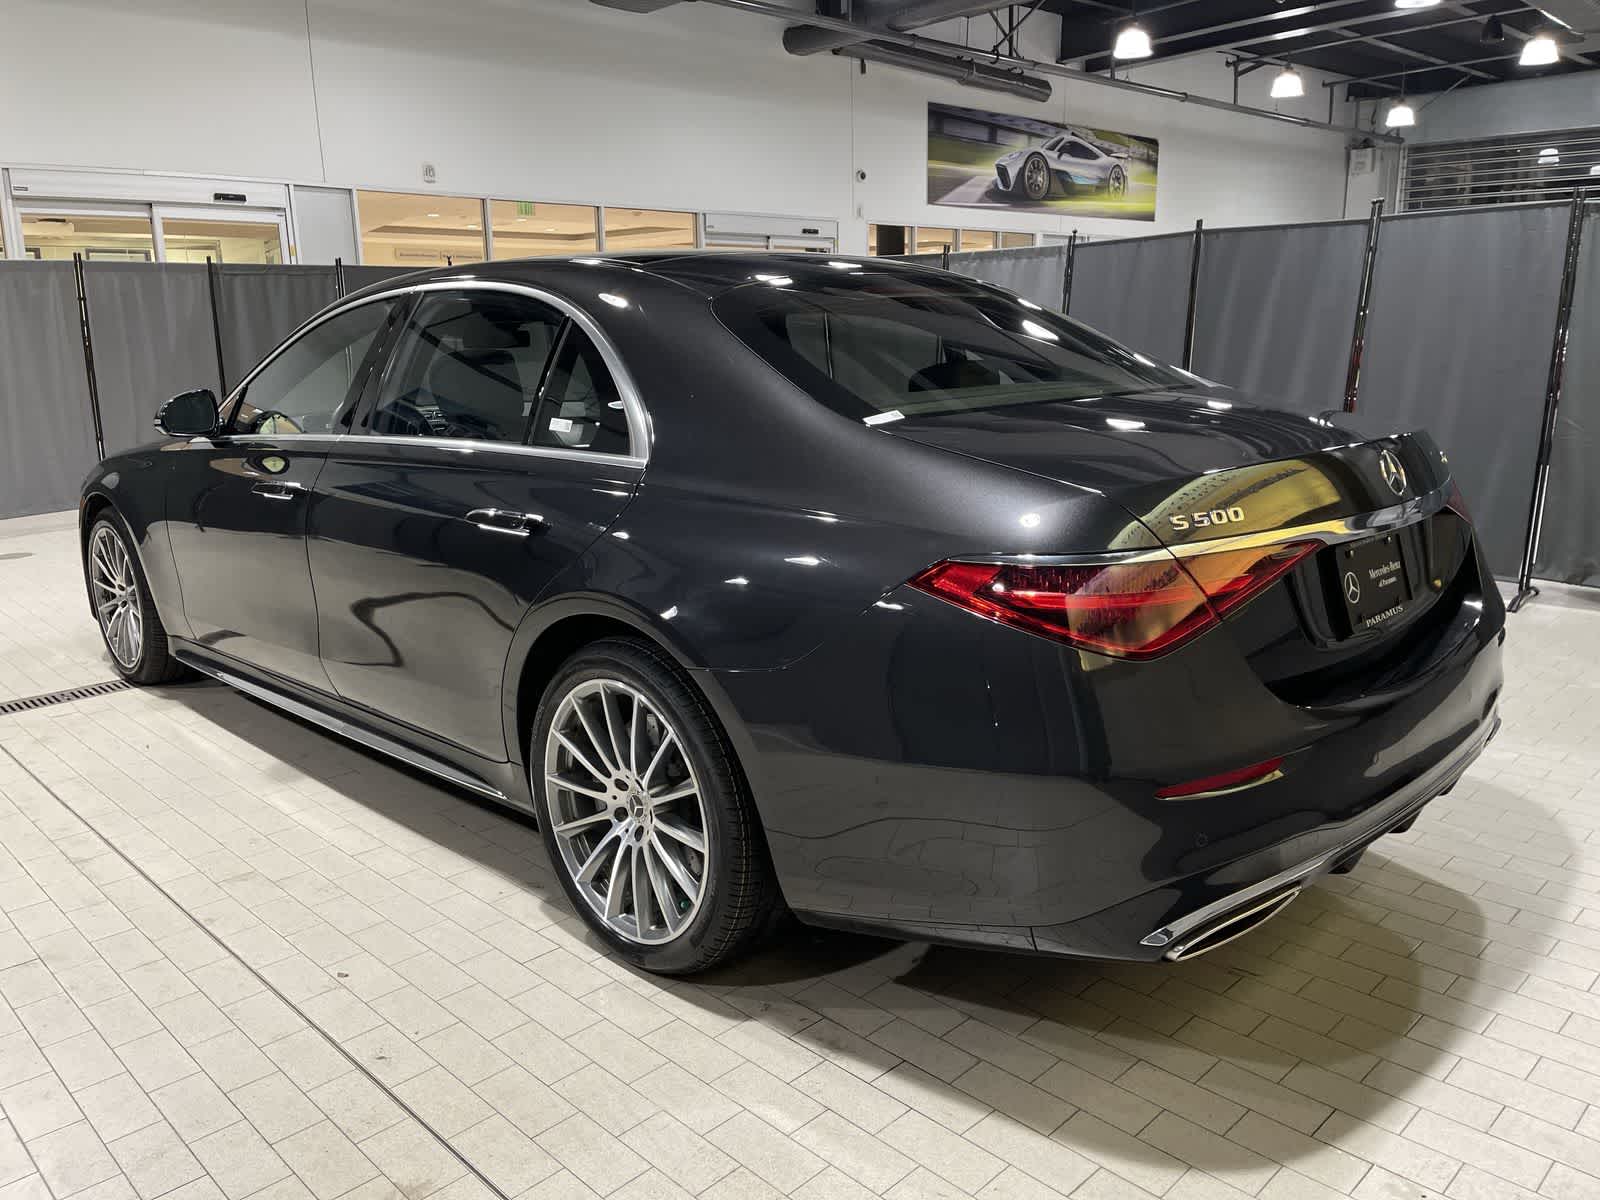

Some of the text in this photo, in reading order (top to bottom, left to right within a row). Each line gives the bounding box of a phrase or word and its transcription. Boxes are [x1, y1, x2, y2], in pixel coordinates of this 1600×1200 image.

[1170, 506, 1245, 531] S 500
[1368, 561, 1401, 578] Mercedes-Benz
[1366, 605, 1404, 627] PARAMUS
